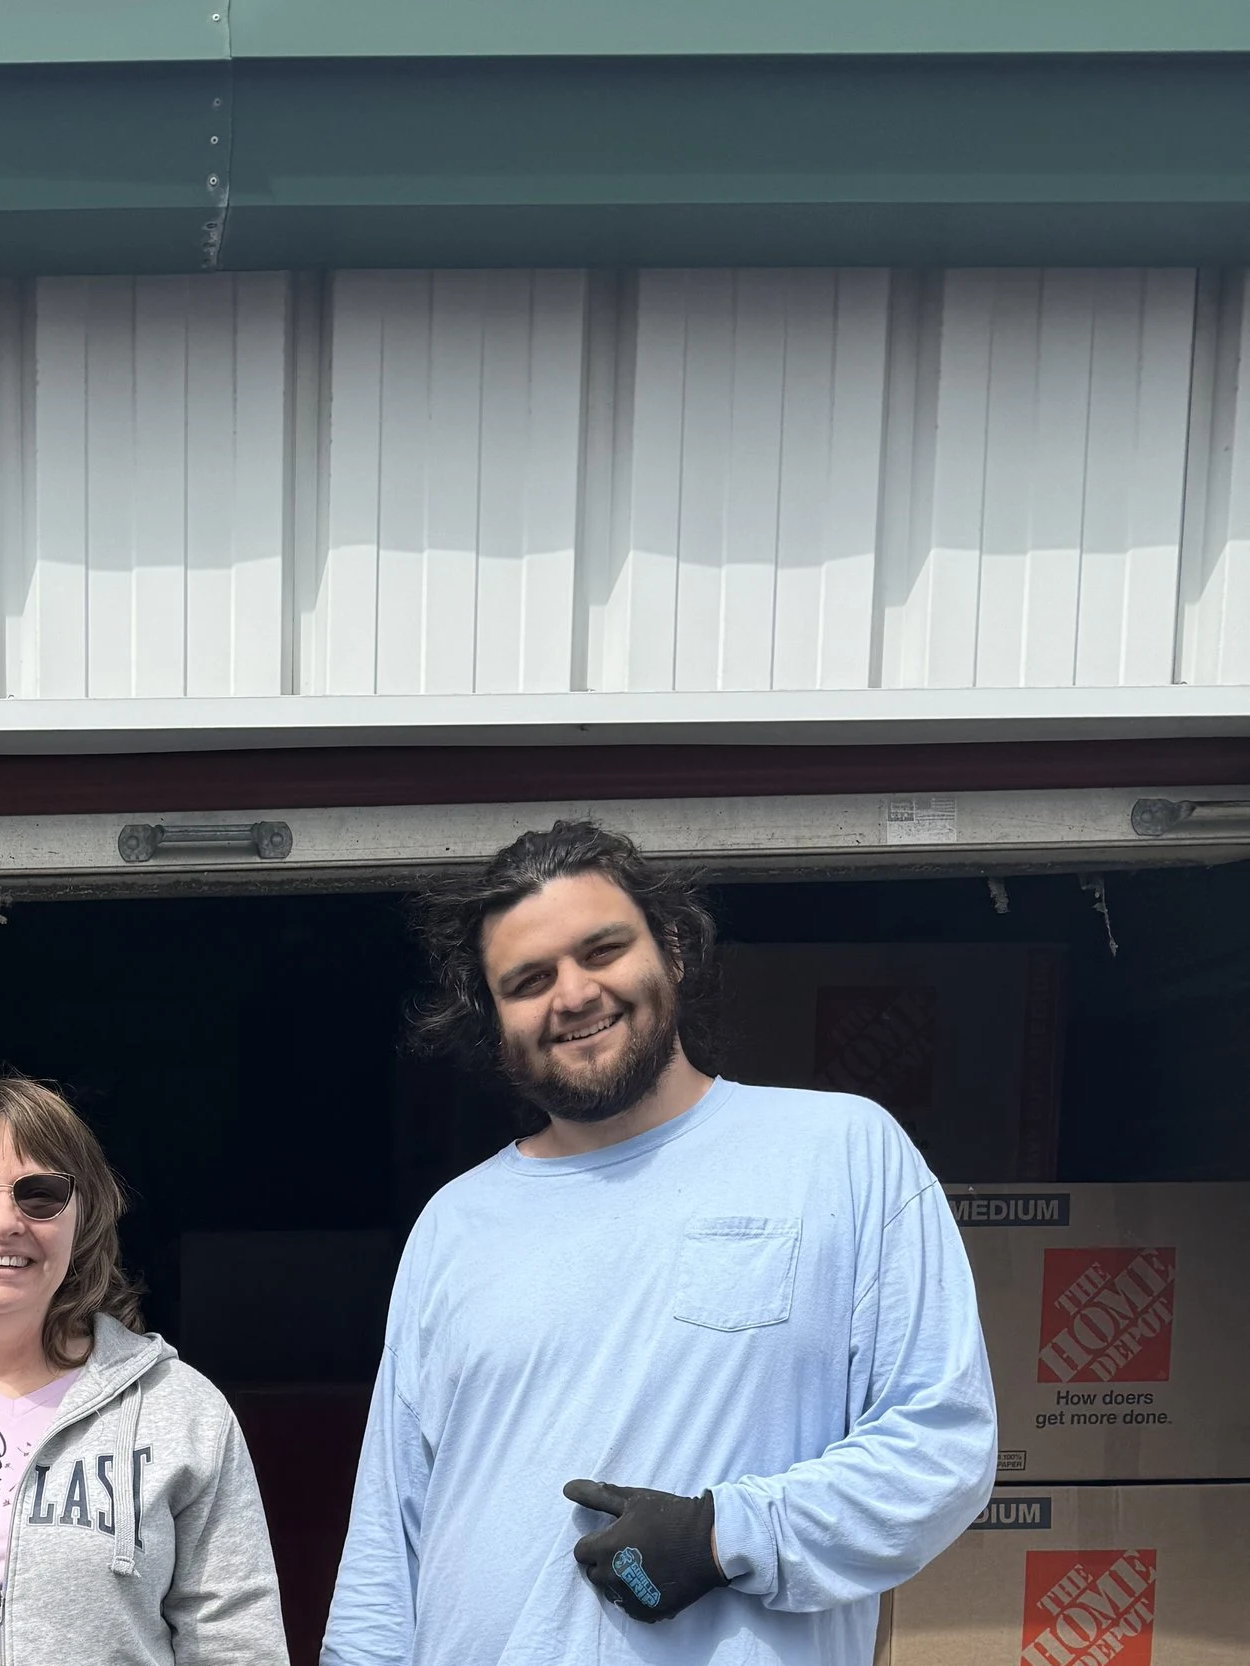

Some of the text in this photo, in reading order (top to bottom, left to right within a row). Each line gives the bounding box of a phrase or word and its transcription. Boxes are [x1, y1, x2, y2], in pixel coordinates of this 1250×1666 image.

[952, 1199, 1059, 1220] MEDIUM
[1054, 1262, 1112, 1316] THE
[1039, 1249, 1175, 1382] HOME
[1090, 1297, 1173, 1382] DEPOT
[1056, 1389, 1154, 1405] How doers
[1036, 1410, 1172, 1429] get more done.
[973, 1503, 1041, 1523] DIUM
[1036, 1563, 1094, 1616] THE
